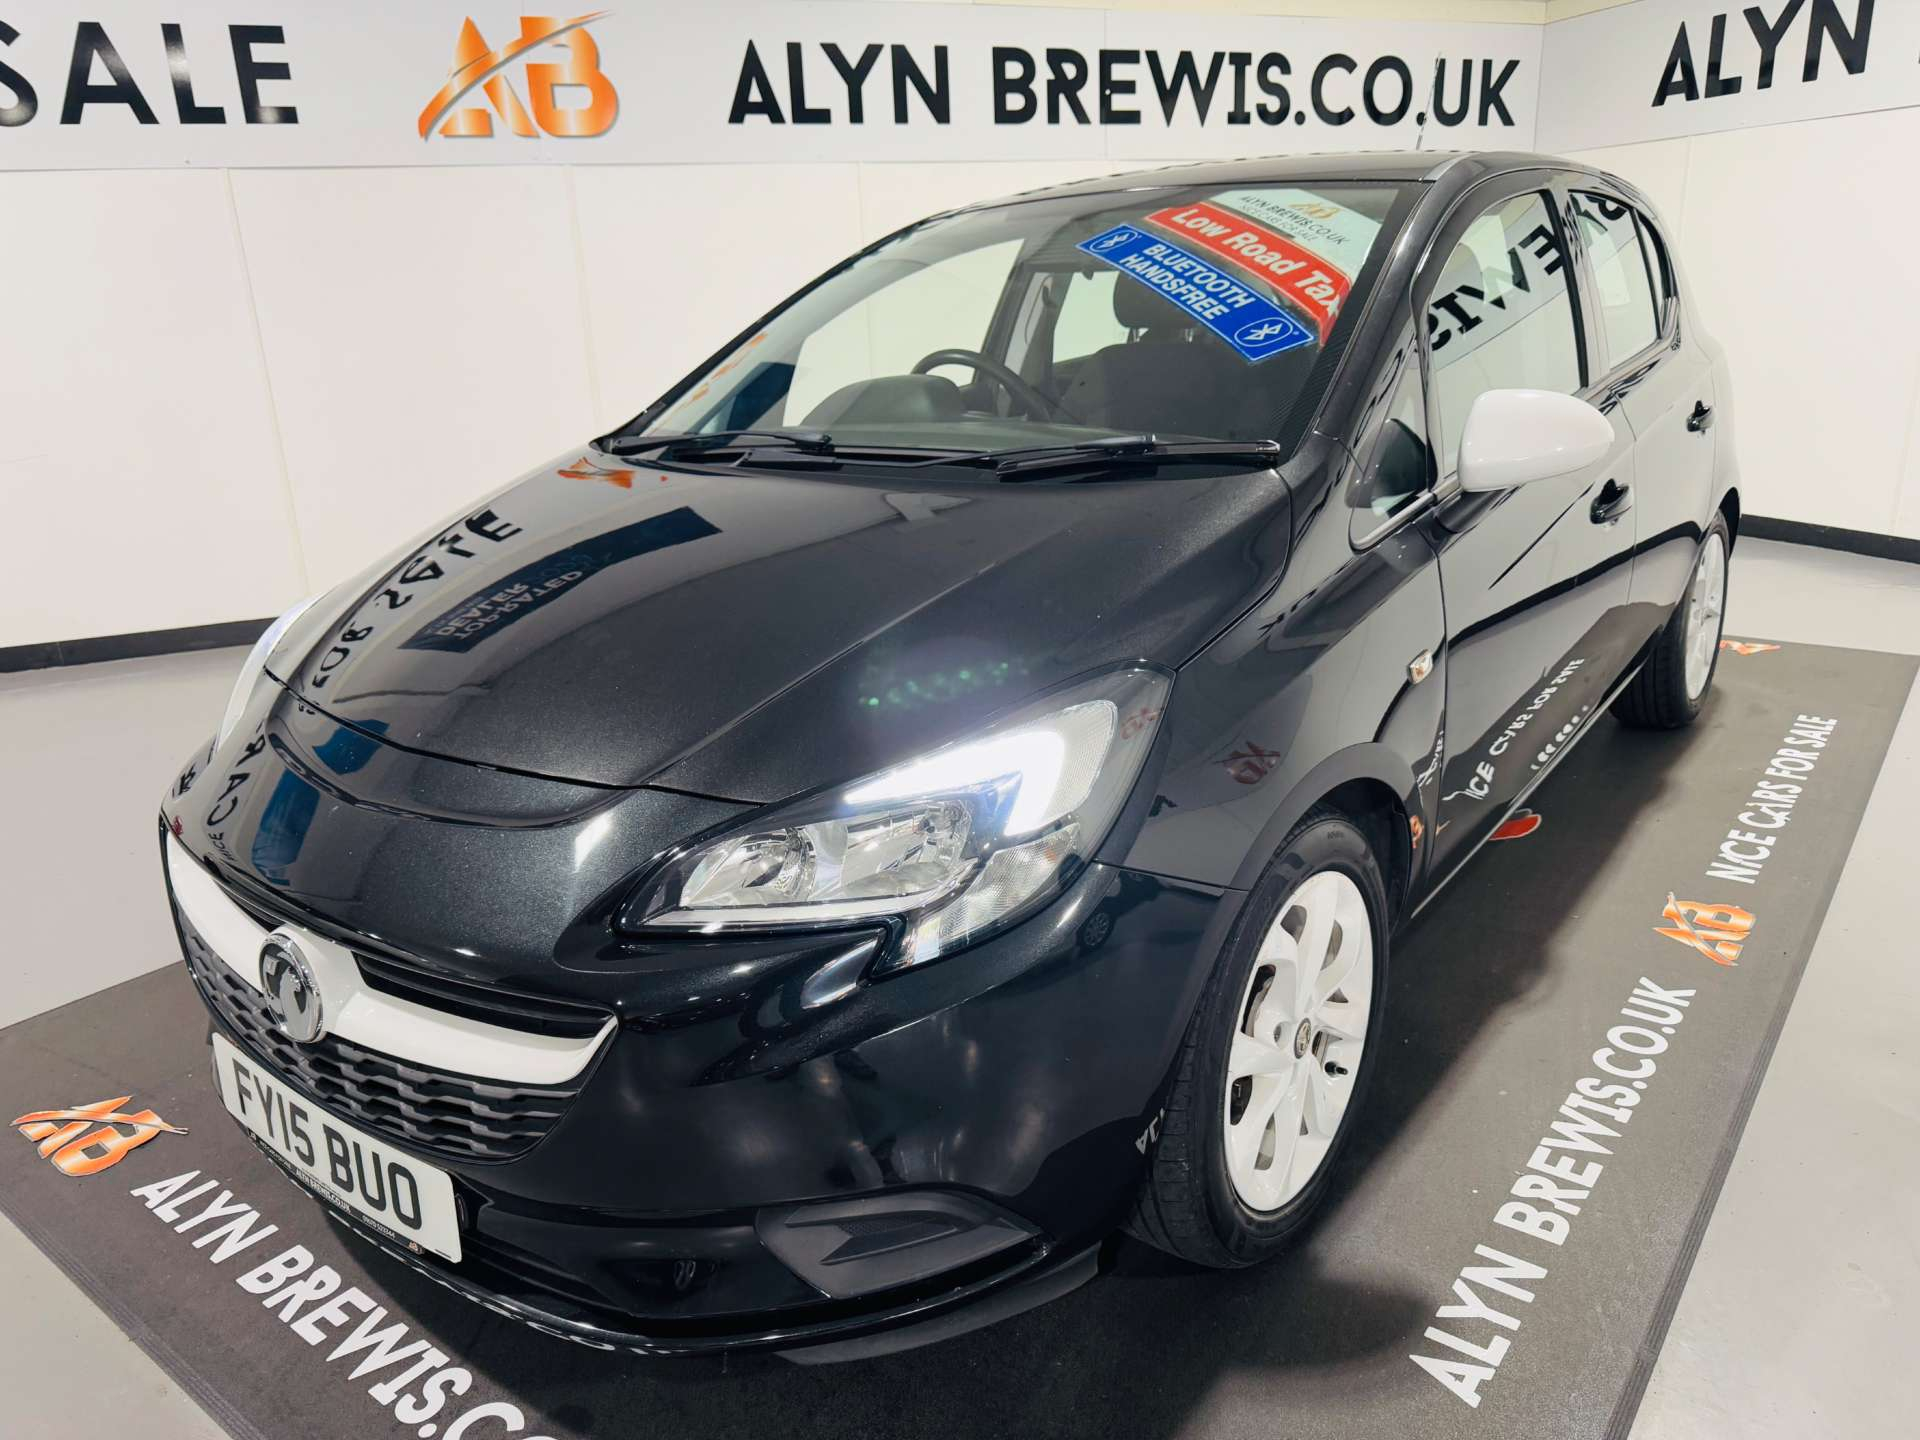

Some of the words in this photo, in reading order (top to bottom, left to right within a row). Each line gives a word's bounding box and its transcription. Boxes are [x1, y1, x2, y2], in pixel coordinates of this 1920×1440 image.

[0, 22, 299, 127] SALE
[728, 40, 950, 124] ALYN
[992, 46, 1520, 128] BREWIS.CO.UK
[1651, 0, 1875, 107] ALYN
[1119, 253, 1230, 320] HANDSFREE
[1142, 243, 1256, 309] BLUETOOTH
[1222, 231, 1302, 276] Road
[1295, 264, 1342, 317] Tax
[1765, 747, 1821, 781] FOR
[1783, 714, 1838, 749] SALE
[1737, 770, 1803, 830] CARS
[1705, 829, 1777, 884] NICE
[232, 1057, 315, 1168] FY15
[322, 1123, 422, 1230] BUO
[1409, 1244, 1548, 1408] ALYN
[1493, 976, 1697, 1246] BREWIS.CO.UK
[130, 1169, 279, 1264] ALYN
[235, 1244, 560, 1440] BREWIS.C
